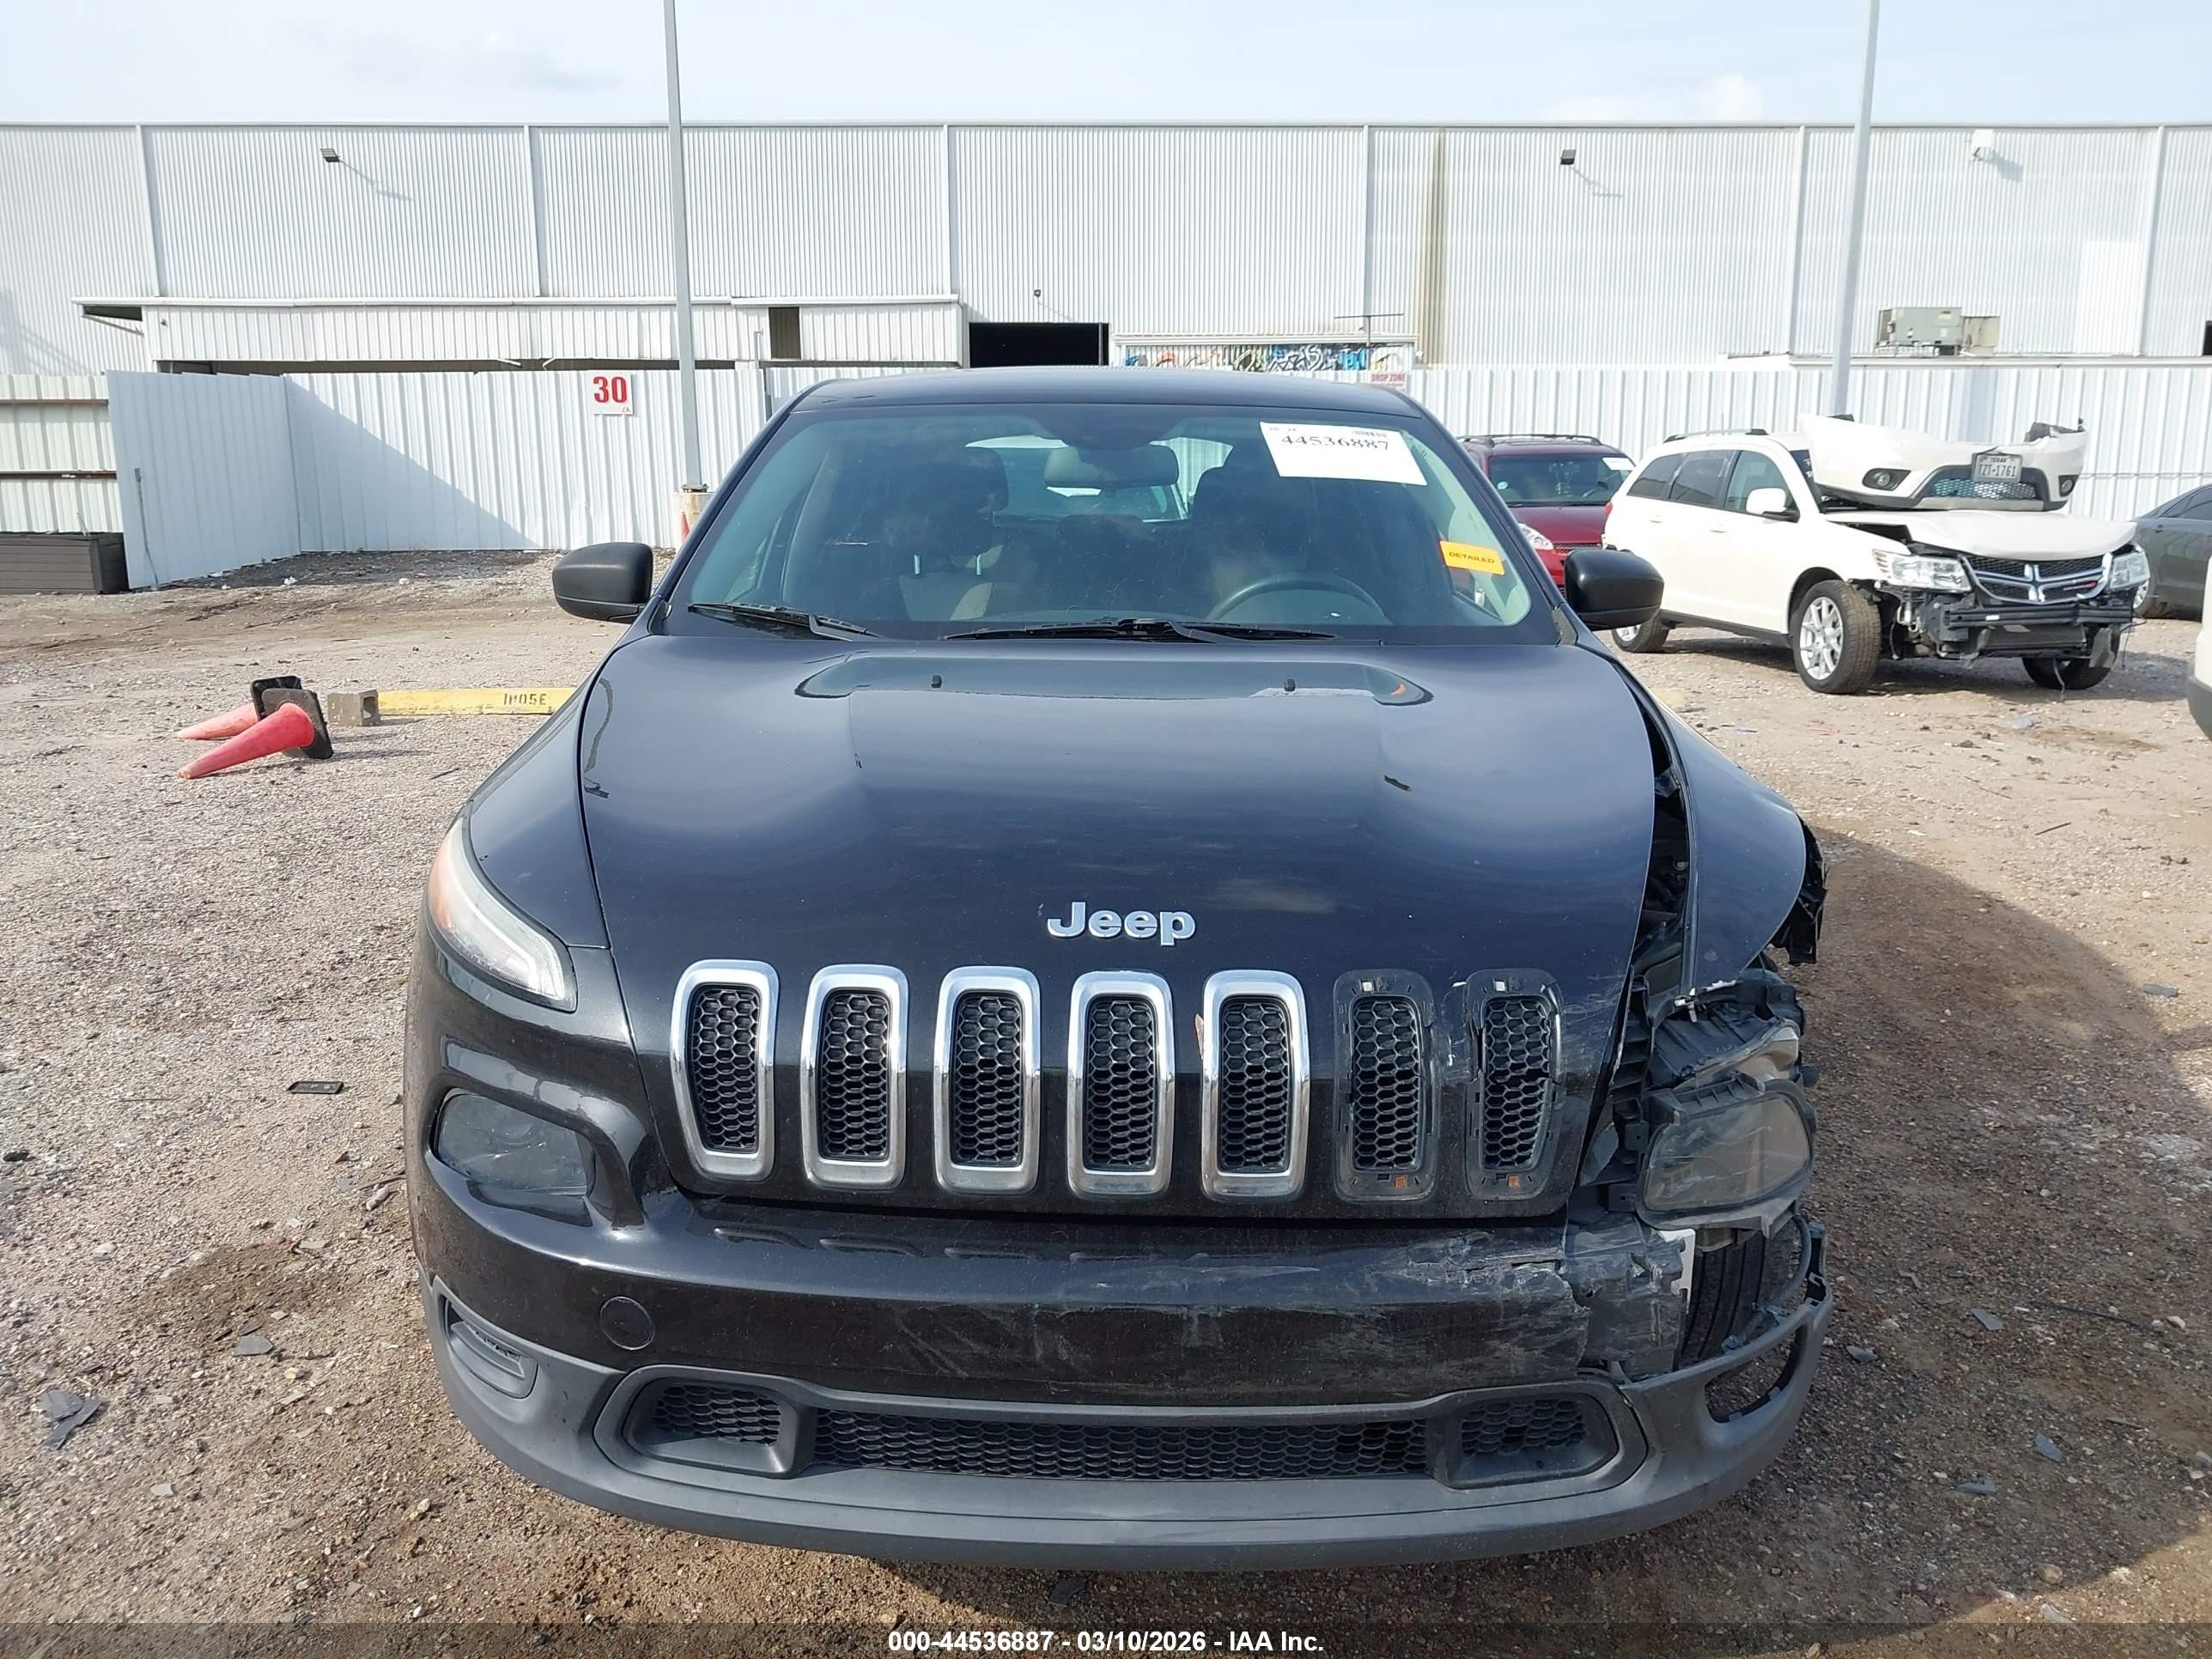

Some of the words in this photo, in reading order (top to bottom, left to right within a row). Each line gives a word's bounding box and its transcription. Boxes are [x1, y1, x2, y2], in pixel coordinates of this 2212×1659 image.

[592, 376, 627, 403] 30
[1281, 434, 1389, 451] 44536887
[1449, 551, 1495, 563] DETAILED
[1047, 902, 1196, 946] Jeep
